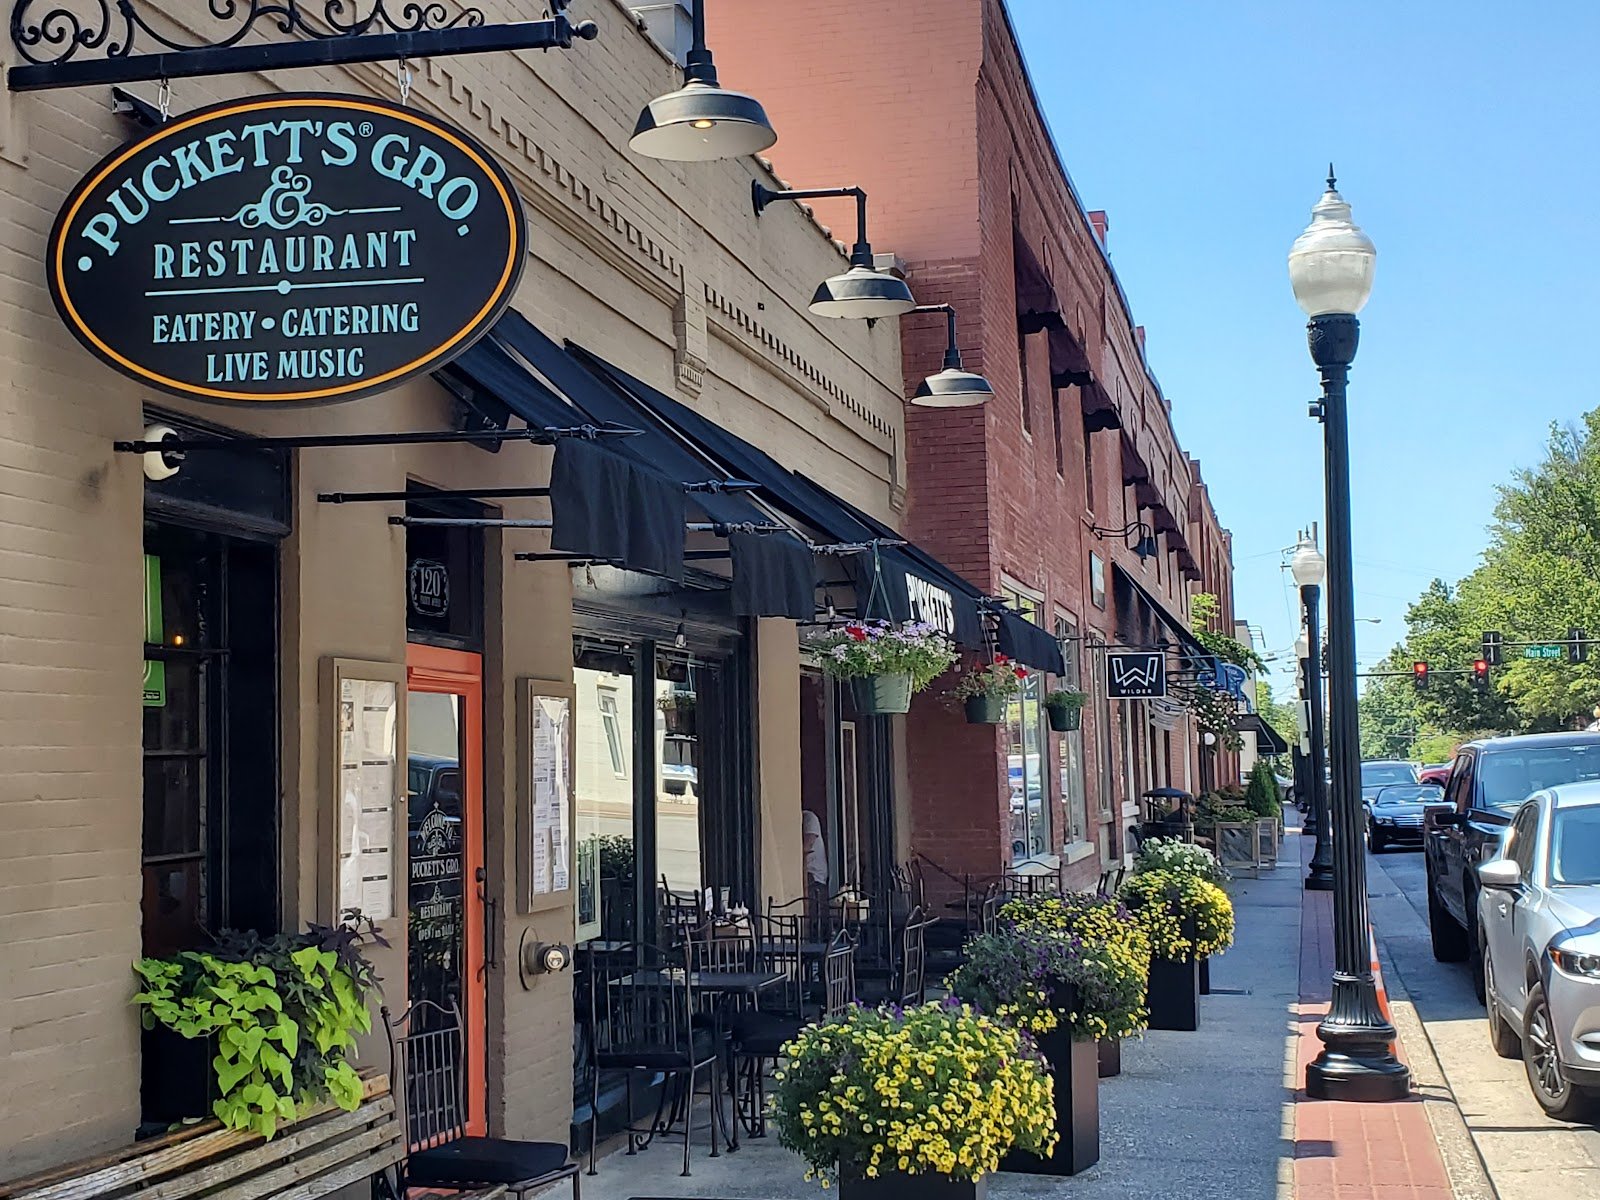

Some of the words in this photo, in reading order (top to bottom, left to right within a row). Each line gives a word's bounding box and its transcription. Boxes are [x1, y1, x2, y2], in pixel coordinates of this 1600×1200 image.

[371, 134, 480, 237] GRO.
[153, 229, 417, 279] RESTAURANT
[152, 310, 257, 343] EATERY
[281, 302, 420, 338] CATERING
[206, 351, 269, 383] LIVE
[276, 347, 365, 380] MUSIC
[420, 567, 441, 597] 120
[1525, 647, 1541, 658] Main
[1542, 646, 1561, 658] Street
[420, 813, 445, 842] WELCOME
[412, 859, 446, 878] PUCKETT'S
